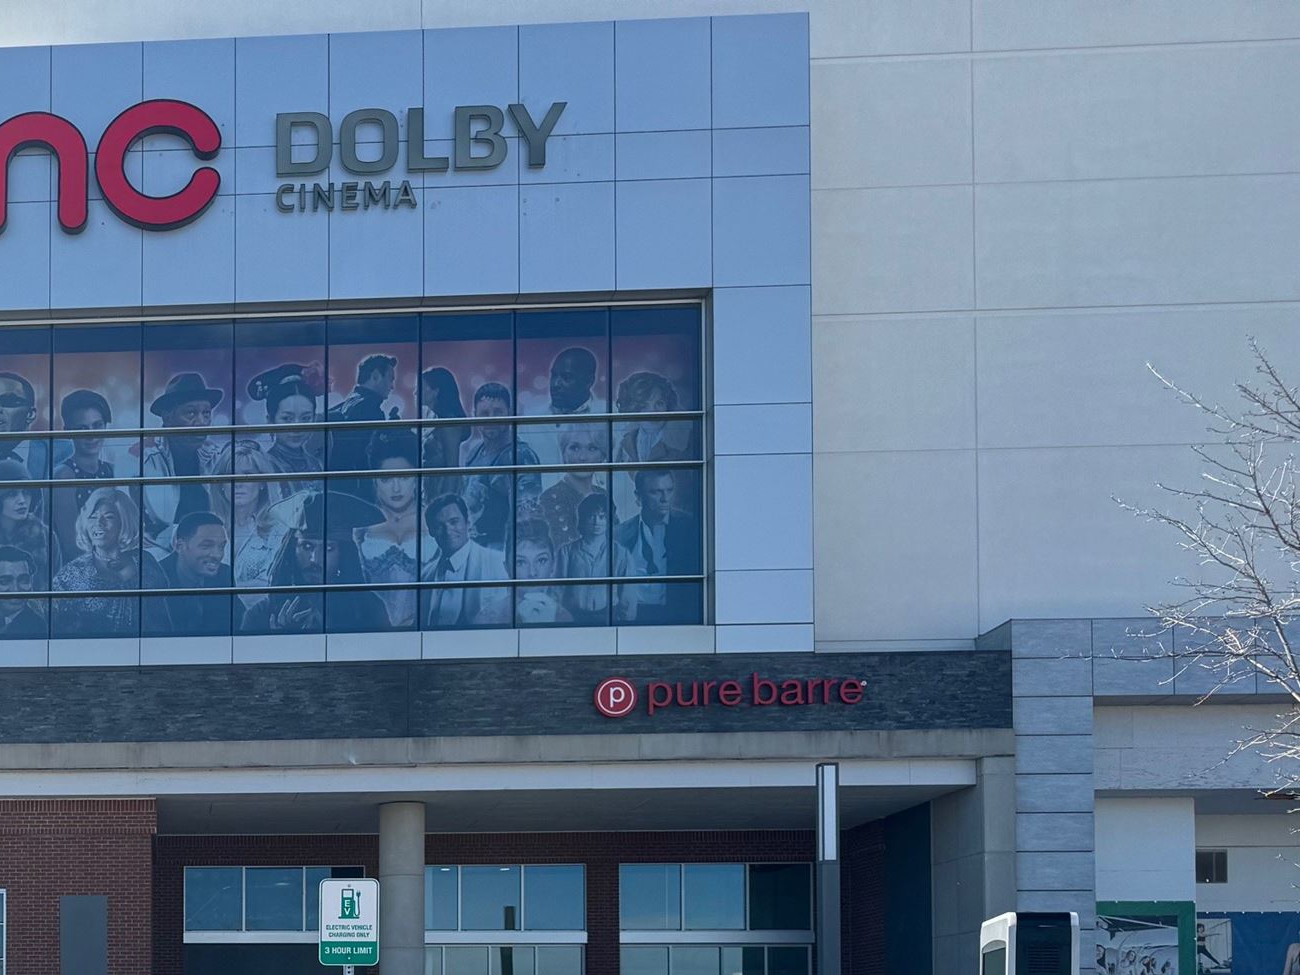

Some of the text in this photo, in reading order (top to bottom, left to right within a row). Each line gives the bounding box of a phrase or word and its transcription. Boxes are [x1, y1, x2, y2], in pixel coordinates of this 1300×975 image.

[275, 101, 568, 178] DOLBY
[275, 180, 418, 213] CINEMA
[647, 680, 743, 715] pure
[752, 672, 864, 706] barre
[324, 946, 373, 954] 3 HOUR LIMIT
